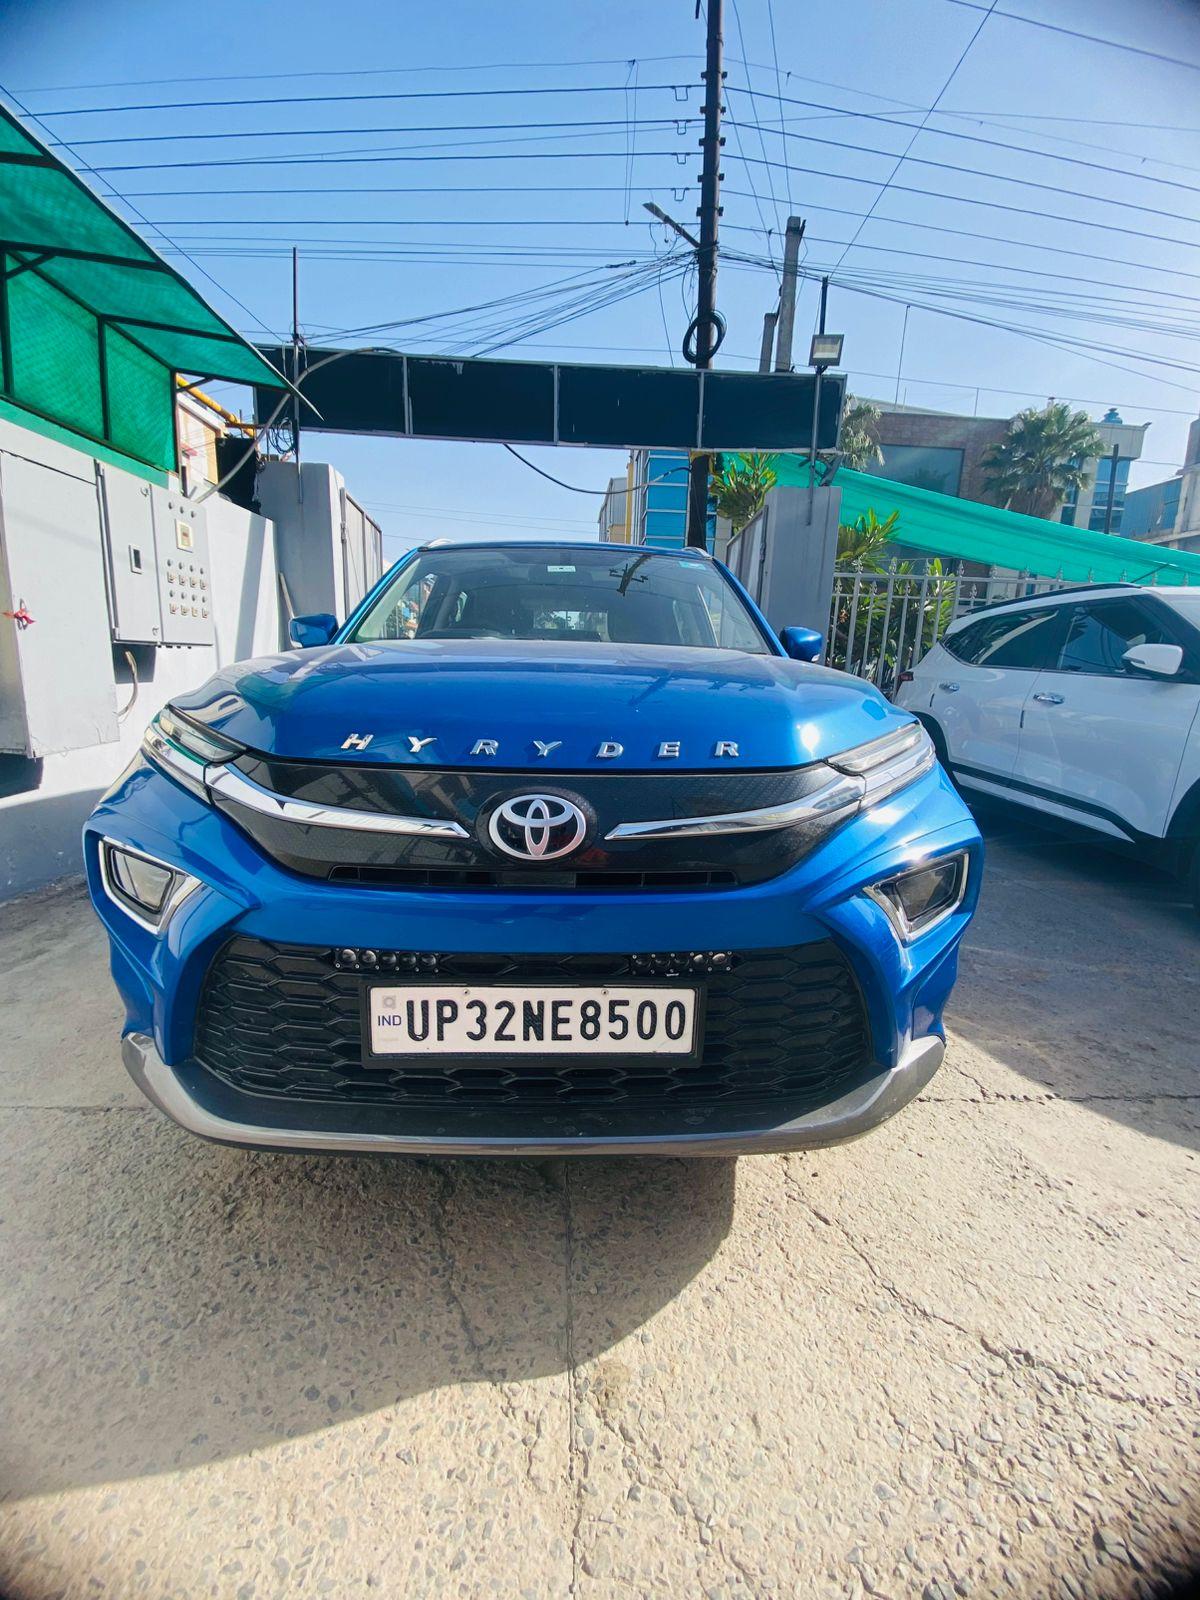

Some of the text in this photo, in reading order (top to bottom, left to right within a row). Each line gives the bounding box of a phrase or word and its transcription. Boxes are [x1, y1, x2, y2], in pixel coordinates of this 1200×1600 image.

[340, 733, 740, 759] HYRYDER
[378, 1015, 402, 1026] IND
[406, 1000, 686, 1041] UP32NE8500
